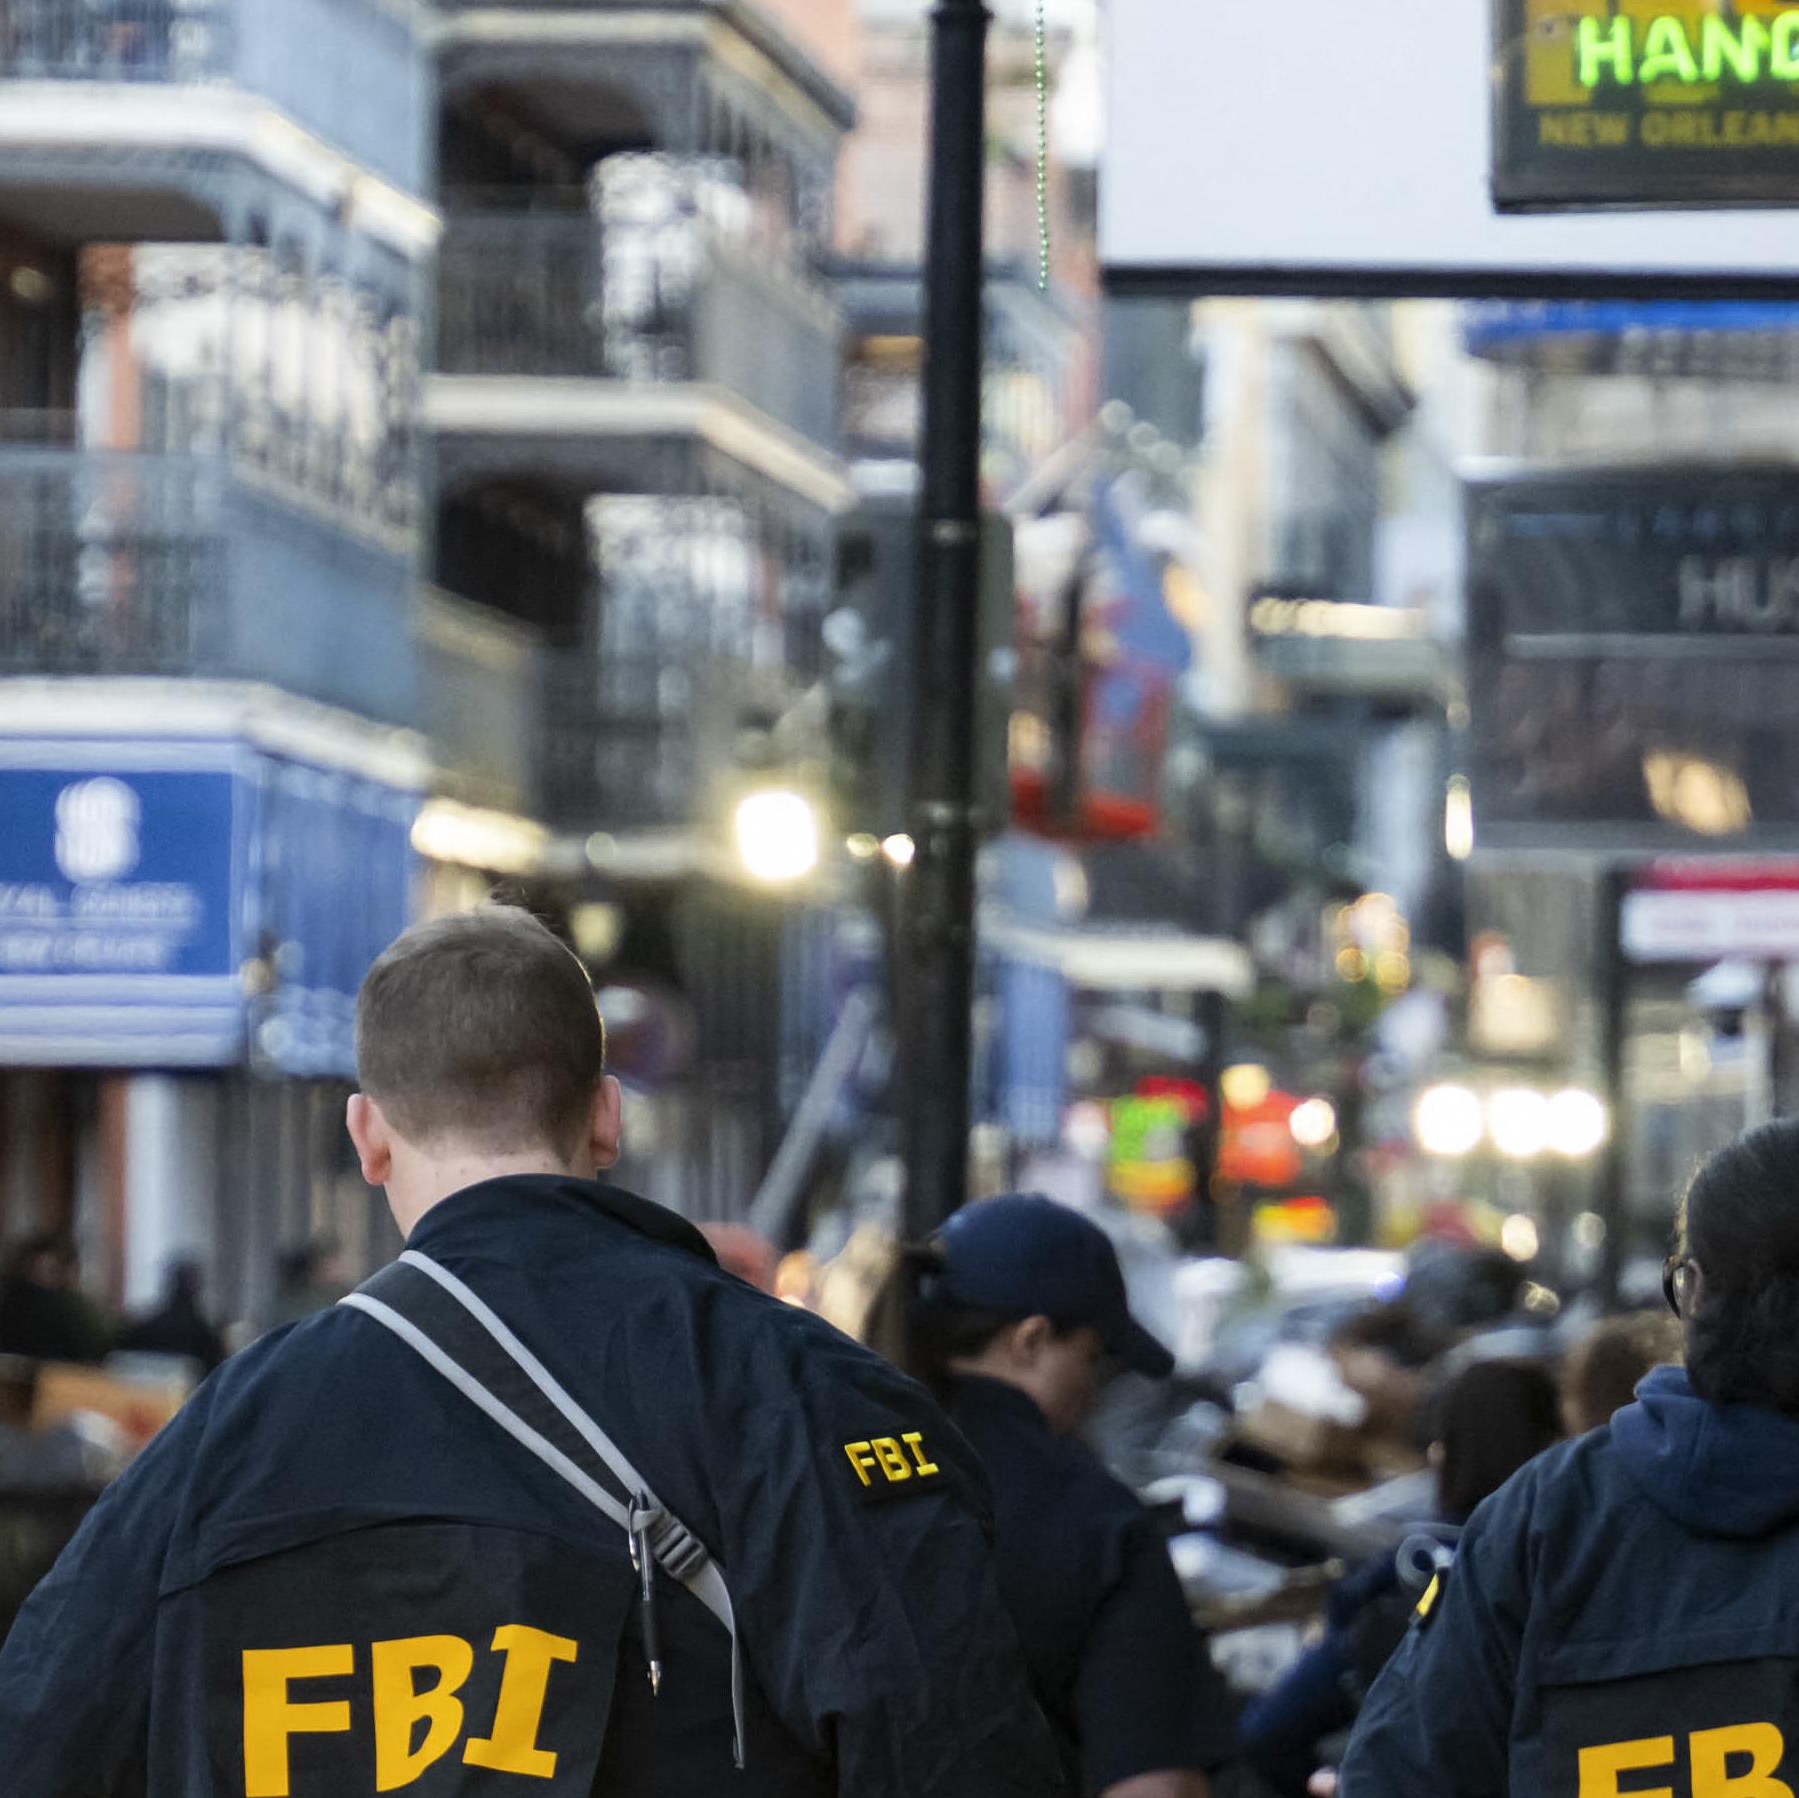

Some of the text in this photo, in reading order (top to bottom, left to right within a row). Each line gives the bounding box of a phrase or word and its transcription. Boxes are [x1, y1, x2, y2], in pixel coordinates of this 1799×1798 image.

[1538, 109, 1629, 147] NEW
[844, 1430, 940, 1488] FBI
[241, 1622, 578, 1798] FBI
